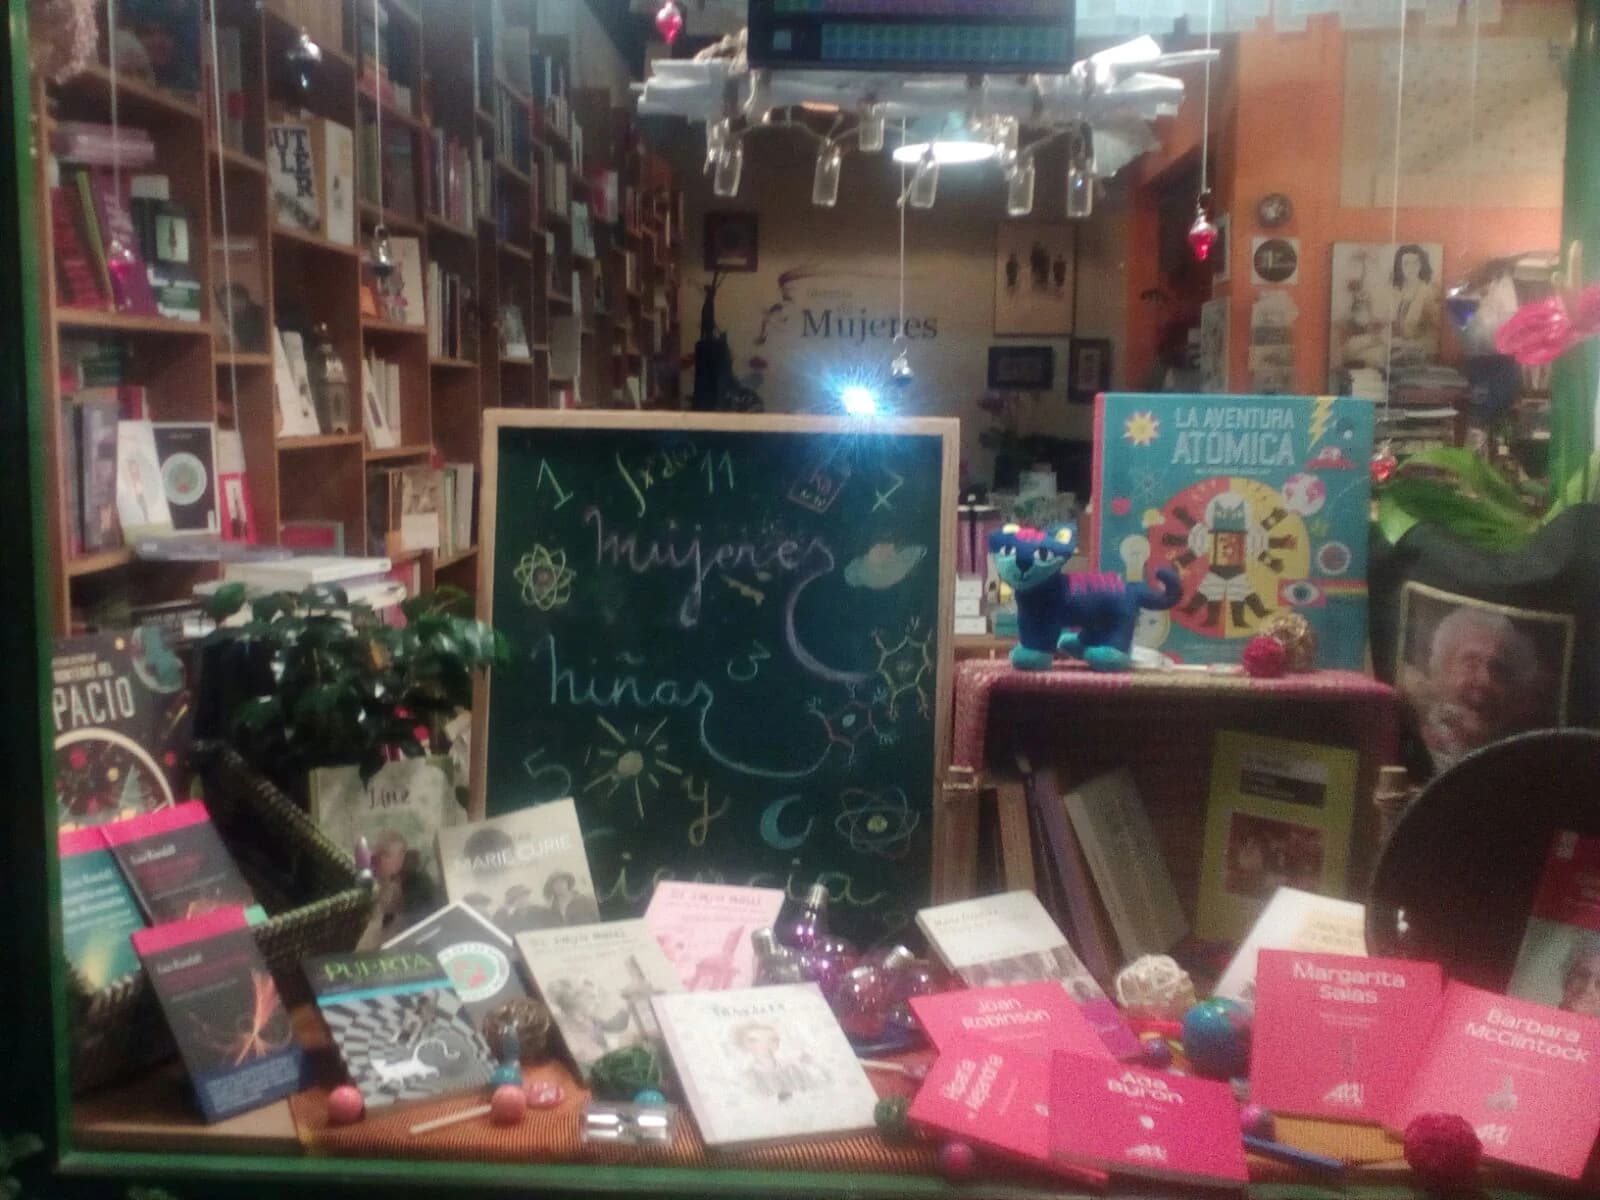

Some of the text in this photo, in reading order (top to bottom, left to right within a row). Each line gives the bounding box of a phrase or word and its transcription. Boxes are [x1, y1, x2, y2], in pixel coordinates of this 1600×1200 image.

[802, 308, 938, 344] Mujeres
[1175, 406, 1295, 429] LA AVENTURA
[531, 633, 714, 706] niñas
[454, 847, 512, 872] MARIE
[517, 835, 570, 862] CURIE
[323, 953, 433, 982] PUERTA
[1292, 961, 1407, 988] Margarita
[1319, 983, 1378, 1004] Salas
[961, 1008, 1051, 1031] Robinson
